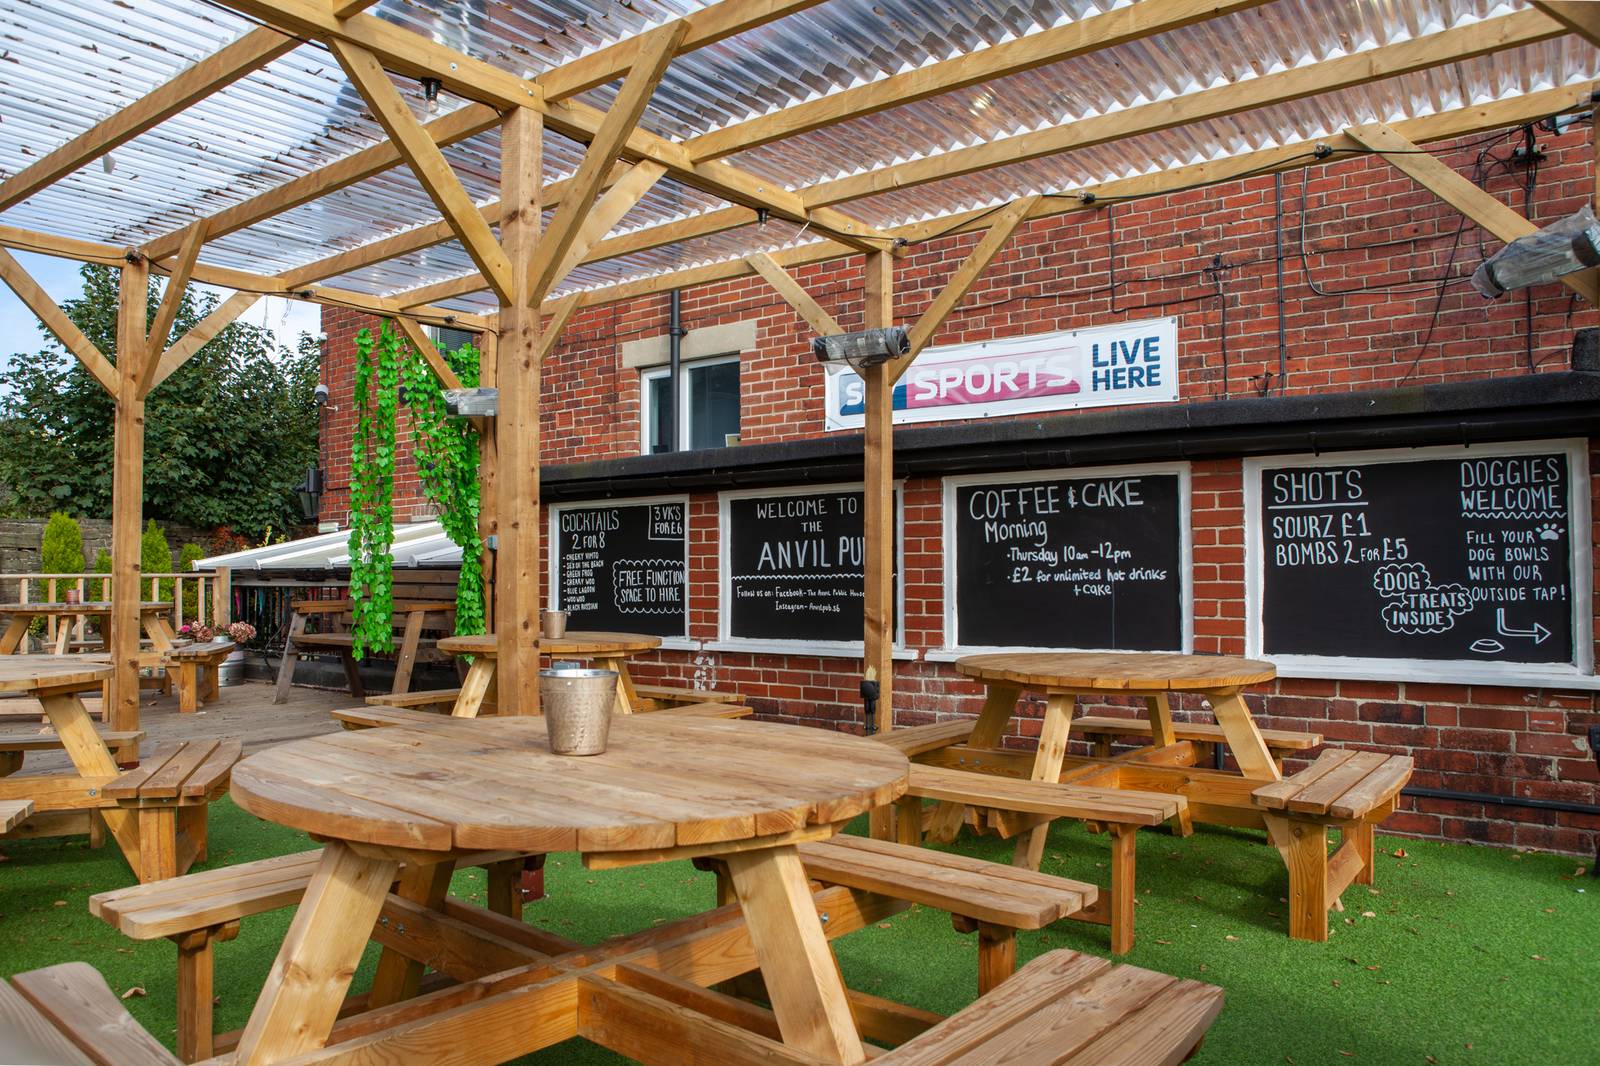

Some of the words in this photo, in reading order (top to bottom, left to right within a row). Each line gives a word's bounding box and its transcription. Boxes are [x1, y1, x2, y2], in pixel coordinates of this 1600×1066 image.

[1091, 336, 1161, 368] LIVE
[914, 354, 1073, 401] SPORTS
[1091, 363, 1162, 392] HERE
[1460, 458, 1560, 488] DOGGIES
[1273, 469, 1362, 504] SHOTS
[970, 486, 1060, 520] COFFEE
[1068, 486, 1078, 508] &
[1082, 479, 1144, 508] CAKE
[1460, 484, 1562, 510] WELCOME
[654, 506, 660, 520] 3
[662, 506, 681, 520] VK'S
[757, 499, 827, 520] WELCOME
[836, 497, 857, 515] TO
[562, 509, 620, 532] COCKTAILS
[655, 522, 670, 534] FOR
[801, 520, 822, 532] THE
[1273, 514, 1336, 539] SOURZ
[1342, 512, 1372, 537] £1
[572, 533, 581, 550] 2
[583, 535, 598, 548] FOR
[600, 532, 606, 548] 8
[984, 519, 1048, 547] Morning
[1466, 530, 1495, 544] FILL
[1501, 530, 1535, 544] YOUR
[757, 538, 831, 571] ANVIL
[838, 536, 864, 566] PU
[1010, 546, 1058, 566] Thursday
[1276, 541, 1338, 566] BOMBS
[1344, 540, 1359, 564] 2
[1361, 548, 1380, 562] FOR
[1383, 538, 1408, 561] £5
[1468, 548, 1496, 561] DOG
[1504, 546, 1549, 562] BOWLS
[590, 560, 604, 568] BEACH
[1468, 566, 1505, 581] WITH
[1513, 564, 1542, 582] OUR
[619, 570, 644, 587] FREE
[646, 570, 684, 586] FUNCTION
[1012, 566, 1032, 583] £2
[1036, 570, 1050, 582] for
[1054, 568, 1100, 581] unlimited
[1107, 568, 1125, 582] hot
[1129, 568, 1167, 581] drinks
[1384, 572, 1420, 592] DOG
[579, 586, 596, 594] LAGOON
[620, 588, 643, 604] SPACE
[644, 588, 656, 602] TO
[659, 587, 680, 602] HIRE
[736, 586, 754, 598] Follow
[1471, 586, 1526, 602] OUTSIDE
[1407, 592, 1467, 609] TREATS
[1392, 610, 1444, 626] INSIDE
